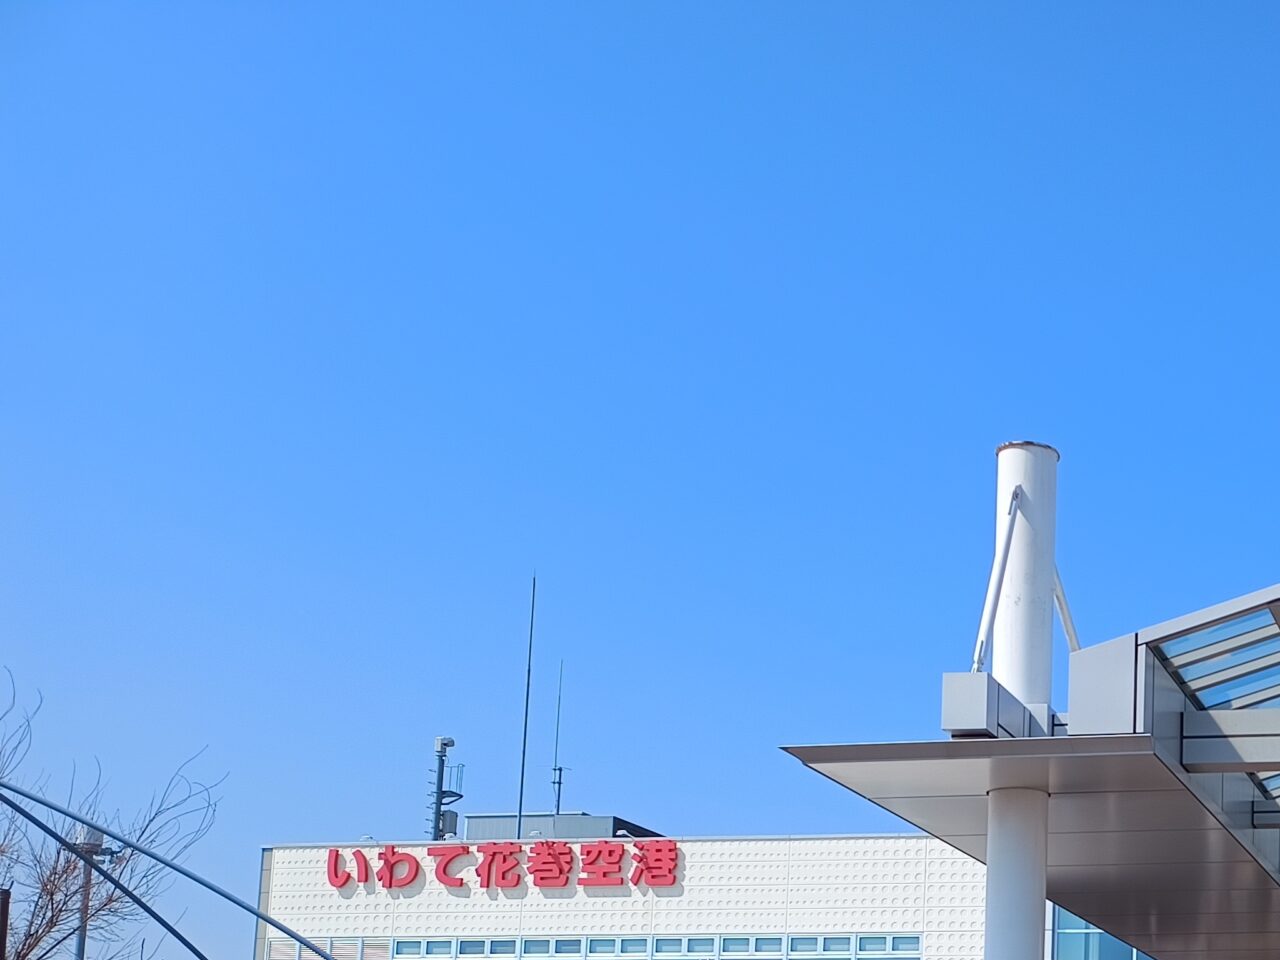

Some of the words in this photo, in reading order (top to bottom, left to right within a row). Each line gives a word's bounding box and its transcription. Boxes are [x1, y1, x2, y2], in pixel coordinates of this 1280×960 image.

[327, 839, 678, 889] いわて花巻空港
